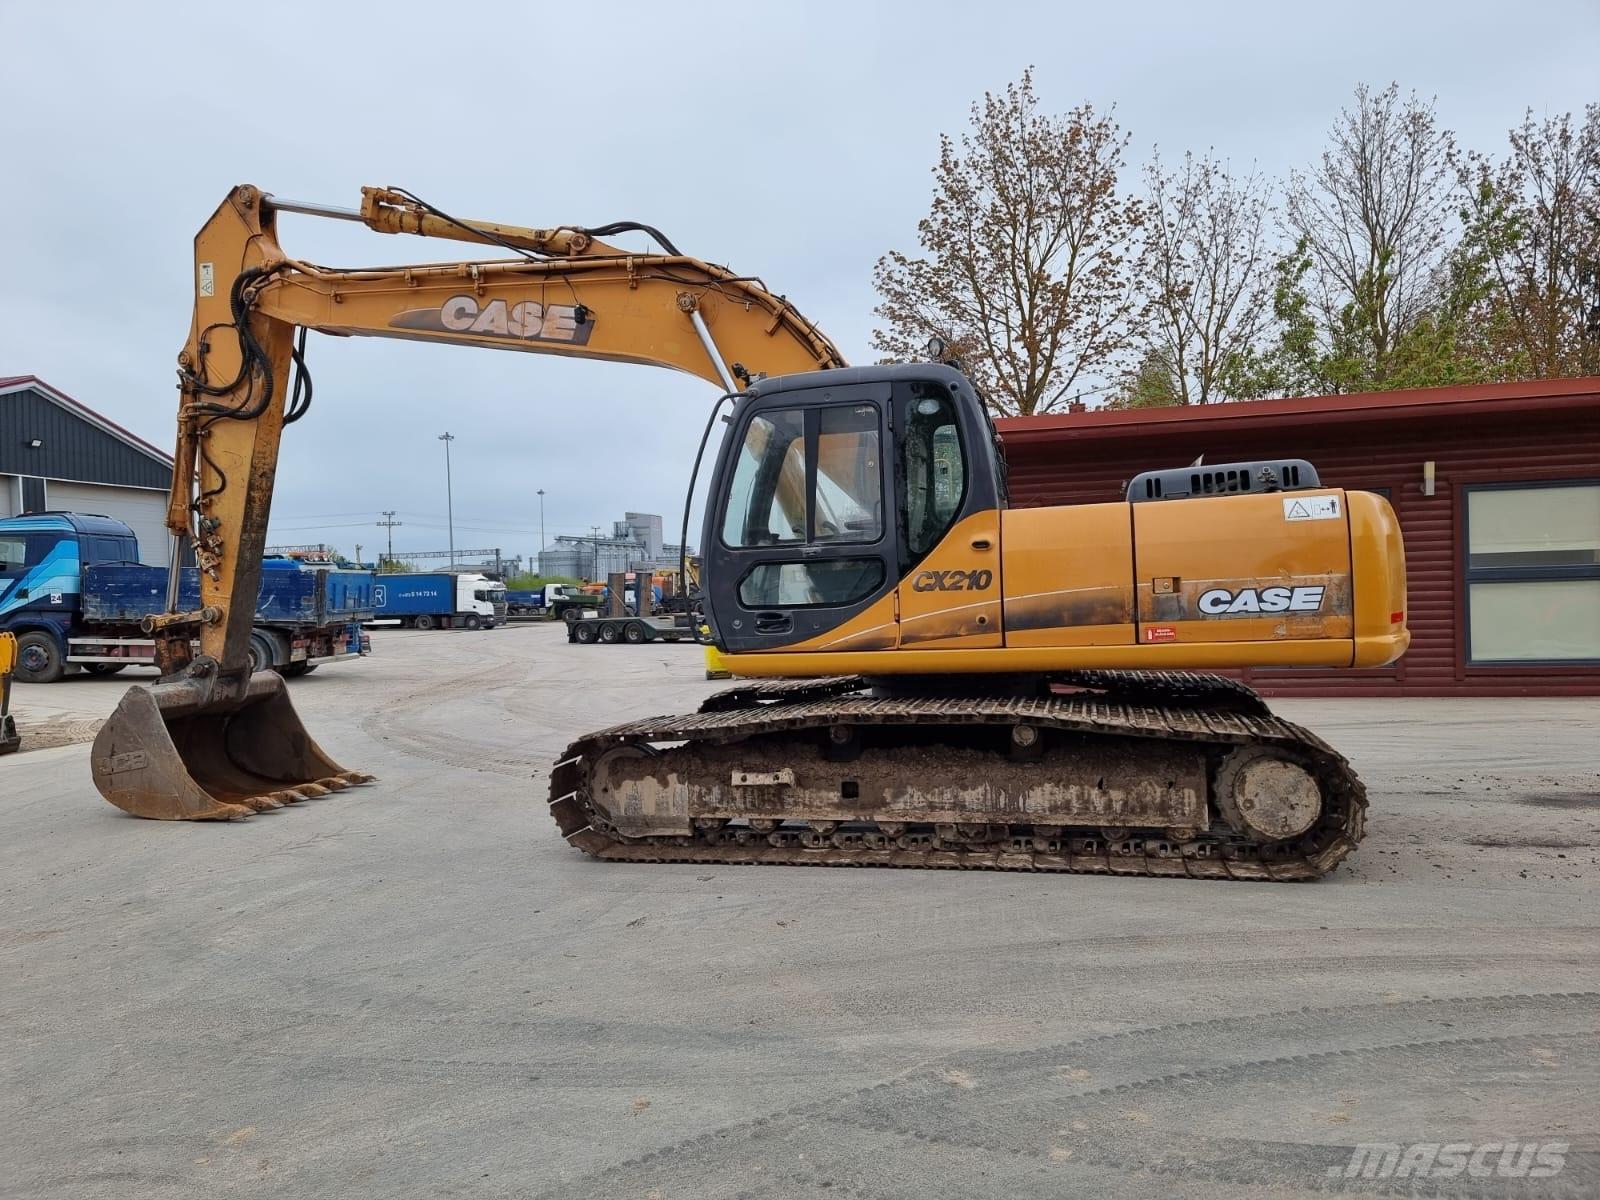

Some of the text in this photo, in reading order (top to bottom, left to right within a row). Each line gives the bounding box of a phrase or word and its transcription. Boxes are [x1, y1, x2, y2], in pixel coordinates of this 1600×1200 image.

[440, 295, 577, 341] CASE
[912, 569, 993, 592] CX210
[1198, 585, 1326, 615] CASE
